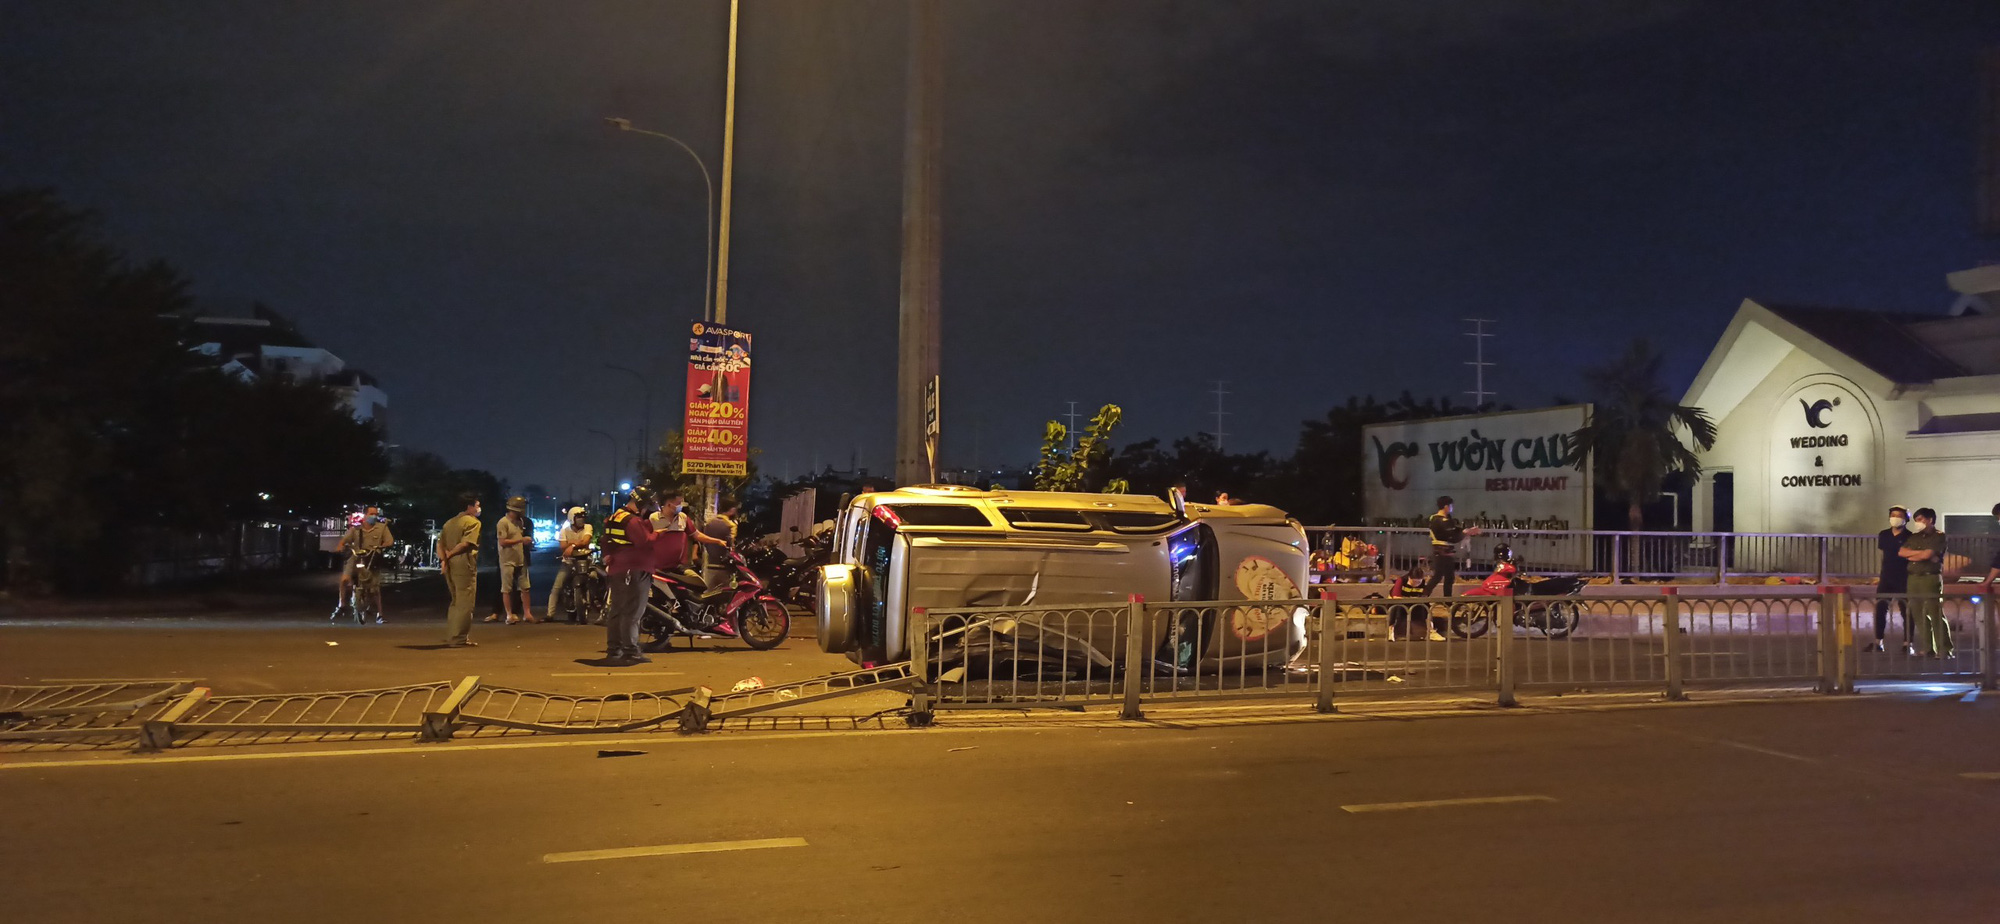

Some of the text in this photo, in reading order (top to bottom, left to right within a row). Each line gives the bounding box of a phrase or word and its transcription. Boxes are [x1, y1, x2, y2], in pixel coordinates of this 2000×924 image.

[705, 327, 752, 339] AVASPORT
[719, 360, 741, 373] SỐC
[689, 401, 709, 410] GIẢM
[709, 402, 745, 419] 20%
[686, 429, 744, 446] NGAY 40%
[687, 428, 707, 436] GIẢM
[1789, 434, 1849, 449] WEDDING
[1428, 428, 1571, 473] VƯỜN CAU
[1814, 455, 1824, 467] &
[1485, 475, 1569, 492] RESTAURANT
[1781, 474, 1862, 488] CONVENTION
